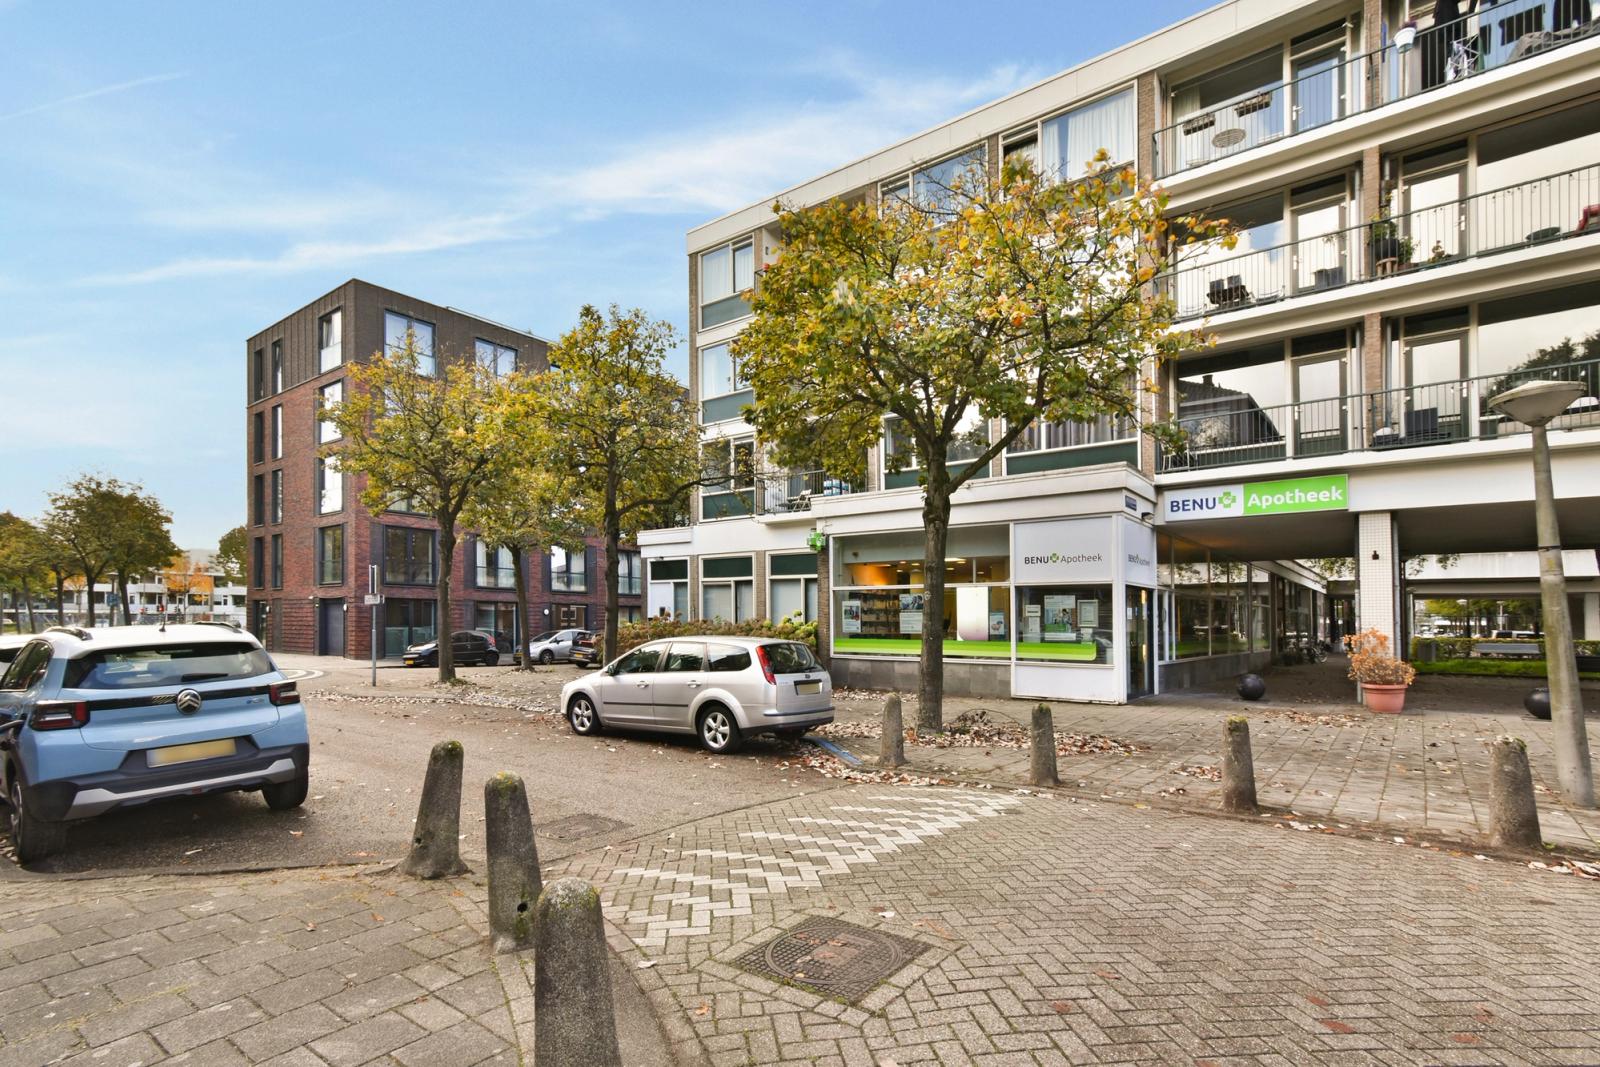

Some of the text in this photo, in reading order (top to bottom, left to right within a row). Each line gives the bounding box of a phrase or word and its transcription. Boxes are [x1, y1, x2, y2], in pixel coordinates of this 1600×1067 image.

[1170, 486, 1343, 513] BENU Apotheek
[1024, 553, 1103, 565] BENU Apotheek
